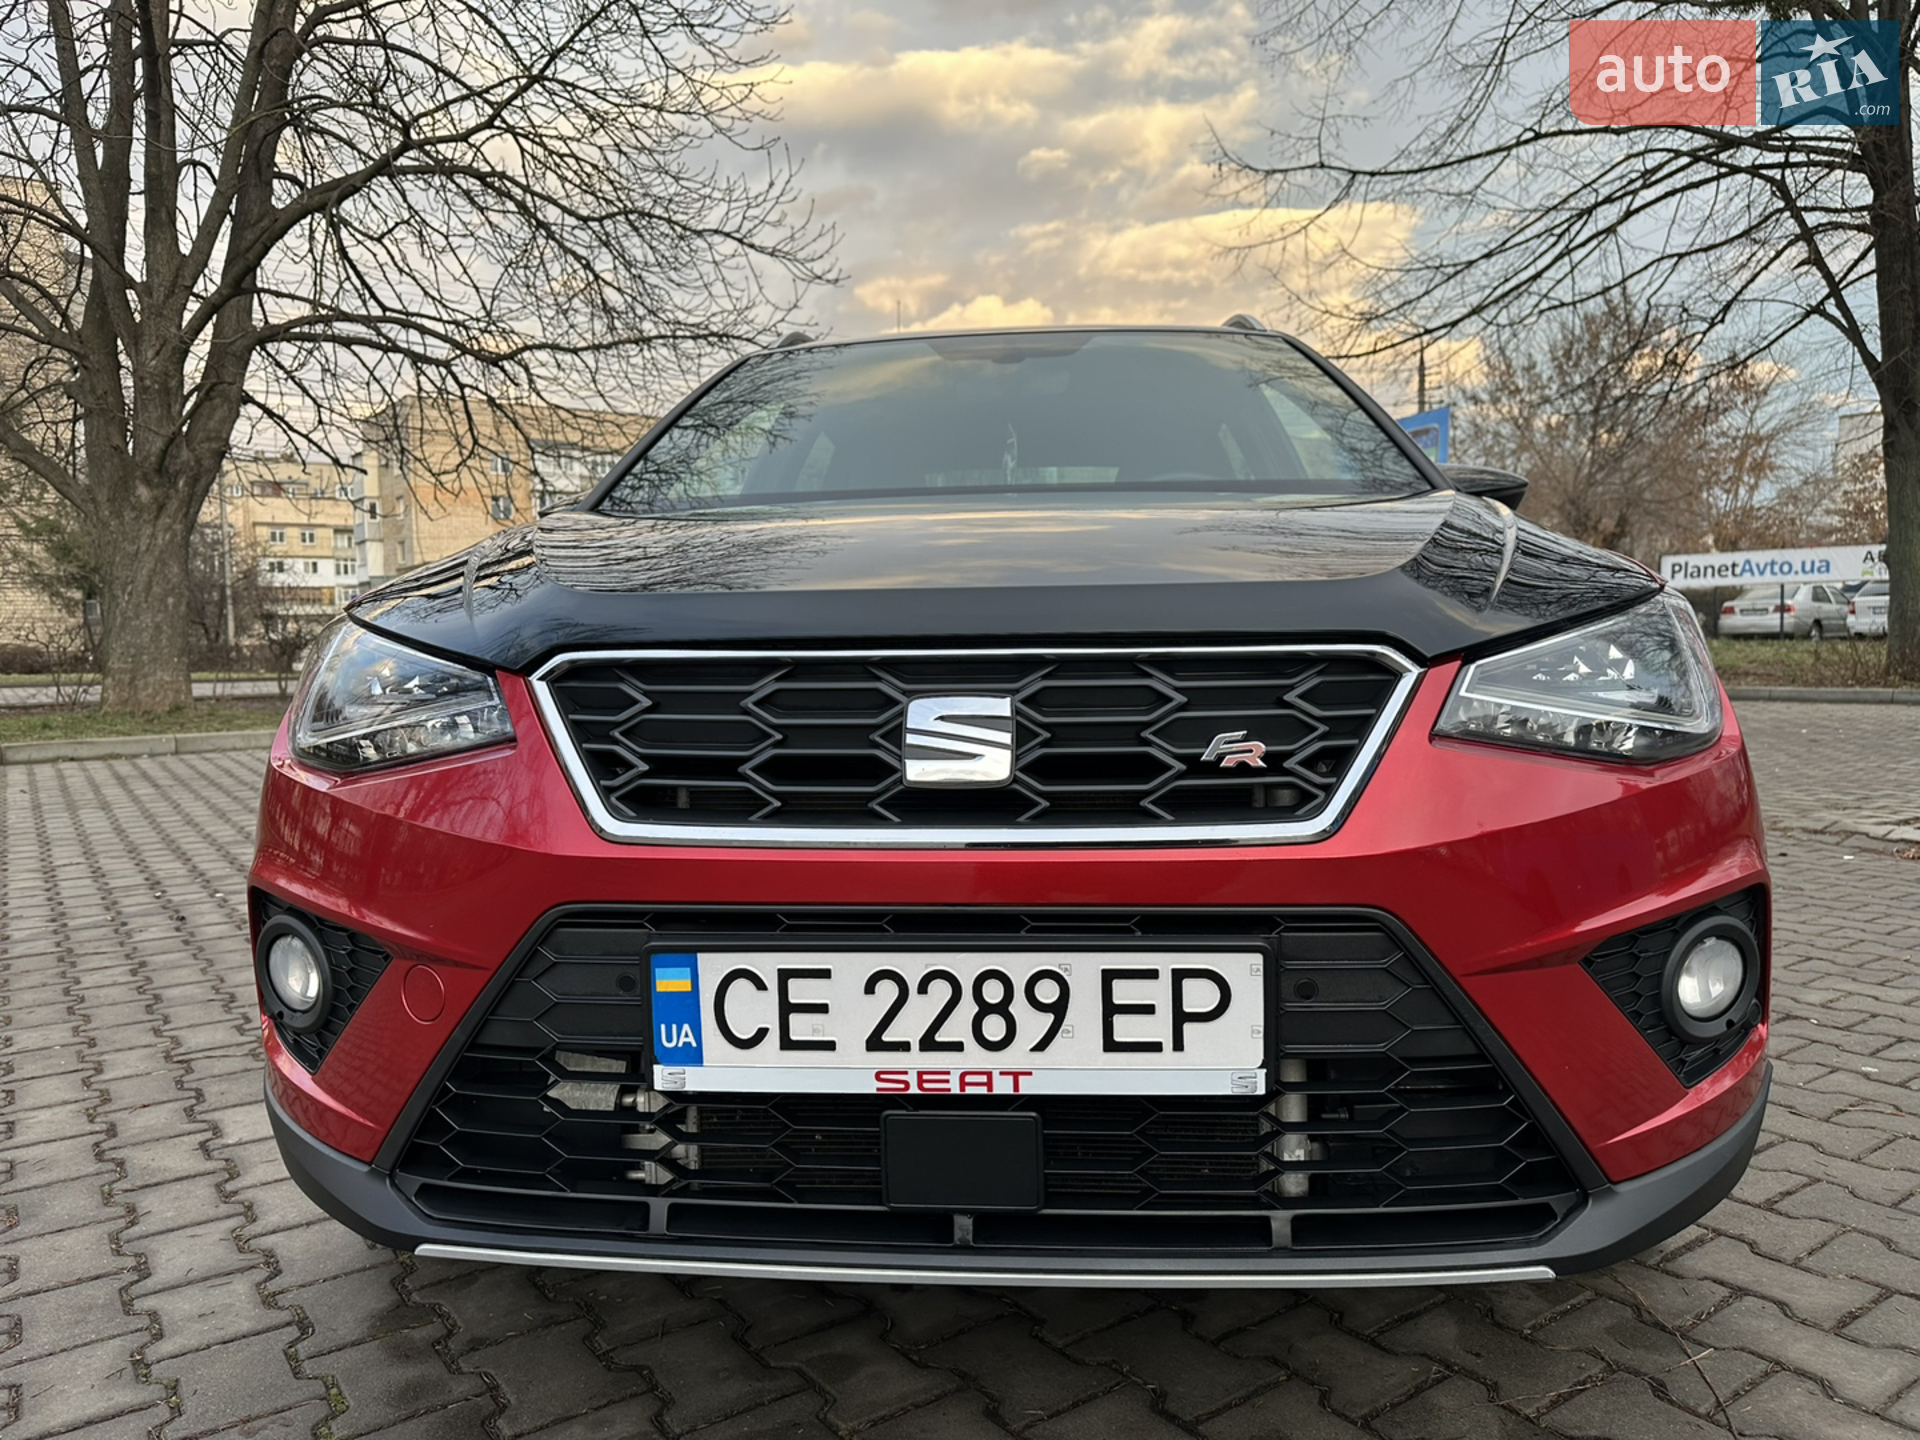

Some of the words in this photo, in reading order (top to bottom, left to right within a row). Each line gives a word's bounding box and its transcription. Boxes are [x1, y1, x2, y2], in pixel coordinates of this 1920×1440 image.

[1671, 558, 1831, 579] PlanetAvto.ua
[1200, 730, 1267, 768] FR
[713, 967, 836, 1051] CE
[863, 967, 1070, 1053] 2289
[1101, 968, 1232, 1052] EP
[660, 1023, 697, 1048] UA
[874, 1070, 1033, 1093] SEAT
